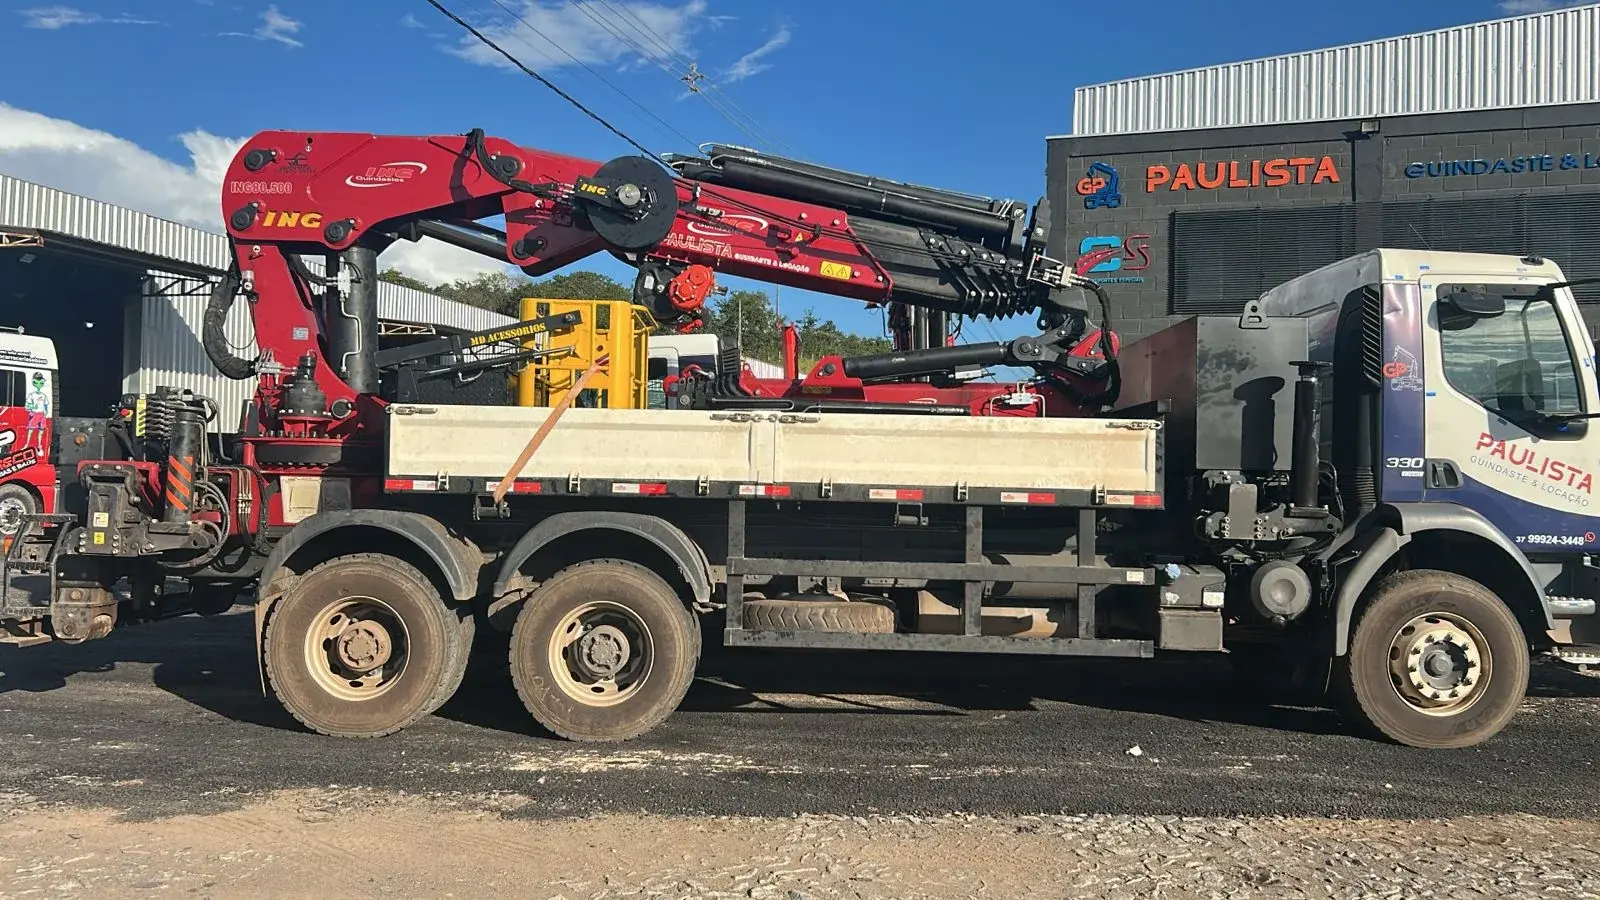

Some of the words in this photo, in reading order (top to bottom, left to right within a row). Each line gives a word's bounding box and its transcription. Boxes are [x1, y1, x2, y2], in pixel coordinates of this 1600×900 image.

[365, 166, 415, 179] ING
[1146, 156, 1341, 193] PAULISTA
[1404, 154, 1554, 179] GUINDASTE
[1559, 153, 1578, 171] &
[1584, 152, 1600, 169] L
[230, 181, 293, 194] ING80.500
[581, 183, 608, 196] ING
[1076, 177, 1106, 196] GP
[262, 210, 324, 229] ING
[664, 231, 733, 259] AULISTA
[470, 335, 483, 346] MD
[487, 322, 546, 343] ACESSORIOS
[1386, 457, 1425, 469] 330
[1476, 432, 1593, 494] PAULISTA
[1470, 455, 1529, 483] GUINDASTE
[1530, 480, 1538, 488] &
[1541, 483, 1589, 507] LOCAÇÃO
[1527, 534, 1585, 546] 99924-3448
